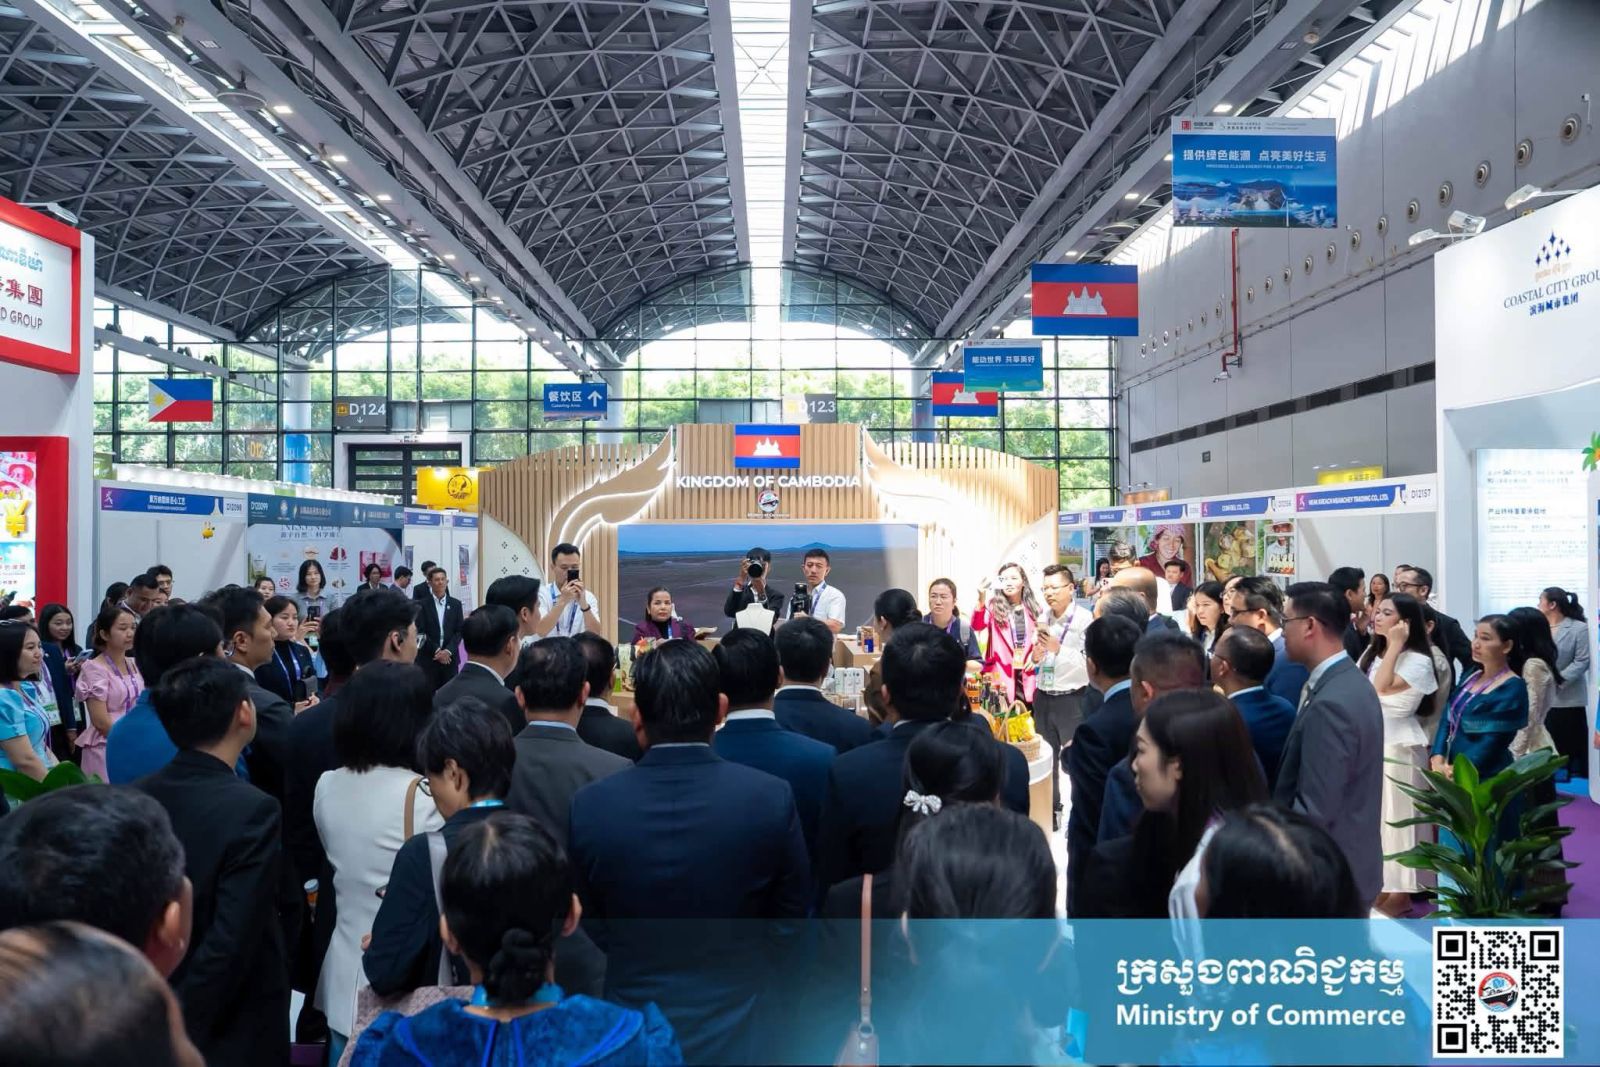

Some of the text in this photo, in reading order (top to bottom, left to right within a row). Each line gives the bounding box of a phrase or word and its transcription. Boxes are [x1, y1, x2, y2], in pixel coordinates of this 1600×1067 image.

[1183, 149, 1327, 163] 提供绿色能源 点亮美好生活
[1503, 287, 1544, 309] COASTAL
[1546, 278, 1570, 296] CITY
[10, 310, 43, 329] GROUP
[548, 390, 582, 402] 餐饮区
[675, 475, 862, 488] KINGDOM OF CAMBODIA
